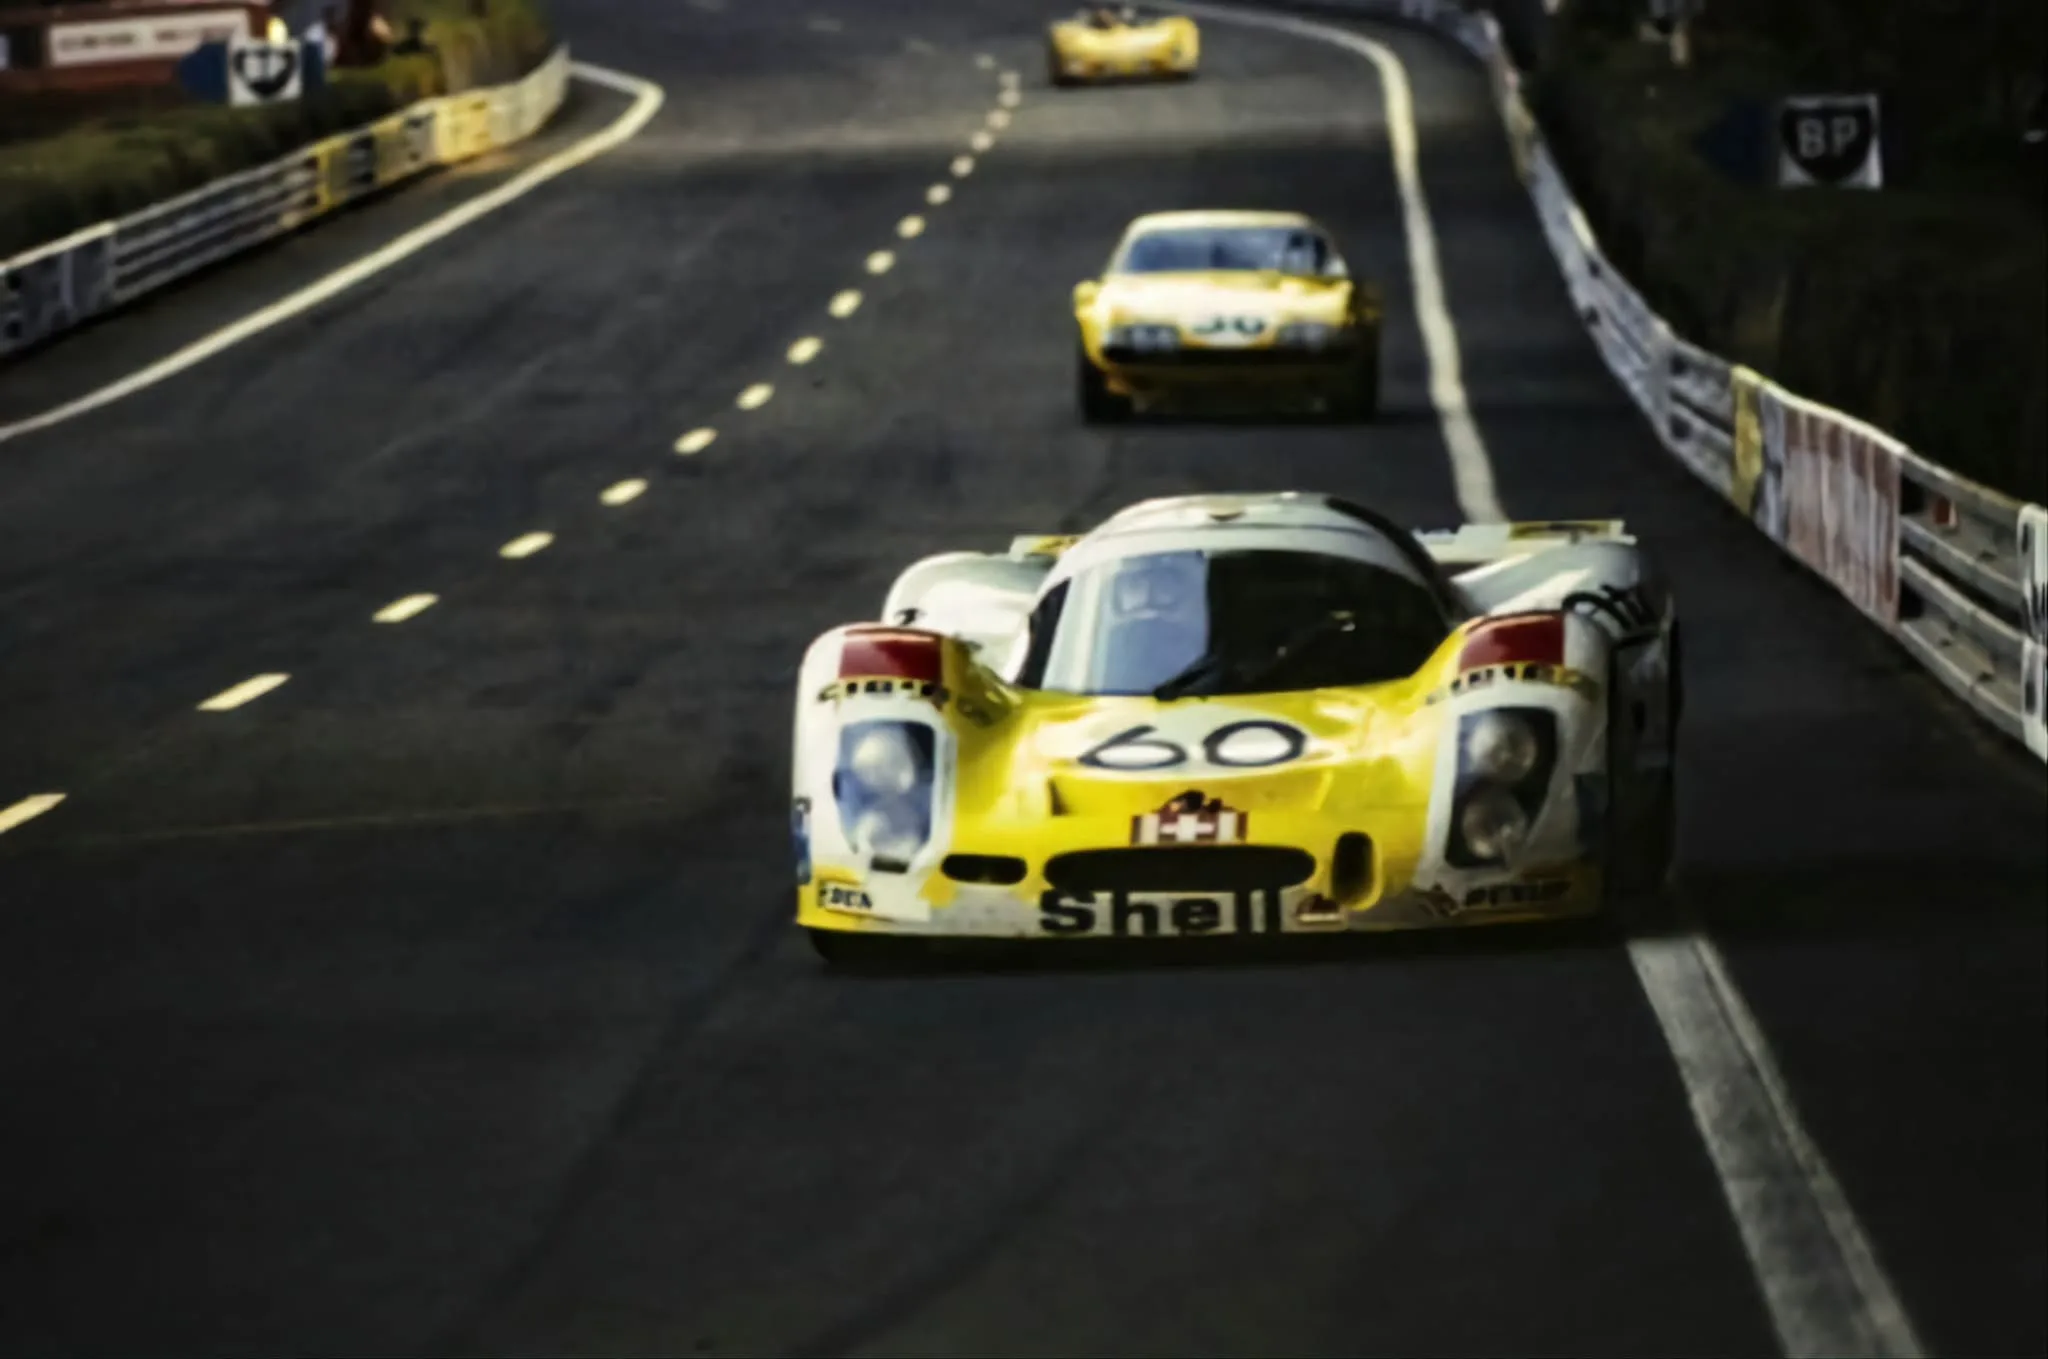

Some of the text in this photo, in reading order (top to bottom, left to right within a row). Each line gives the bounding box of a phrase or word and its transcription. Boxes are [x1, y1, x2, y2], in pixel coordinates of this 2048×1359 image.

[1796, 116, 1859, 158] BP
[1077, 719, 1307, 771] 60
[1039, 888, 1282, 938] Shell
